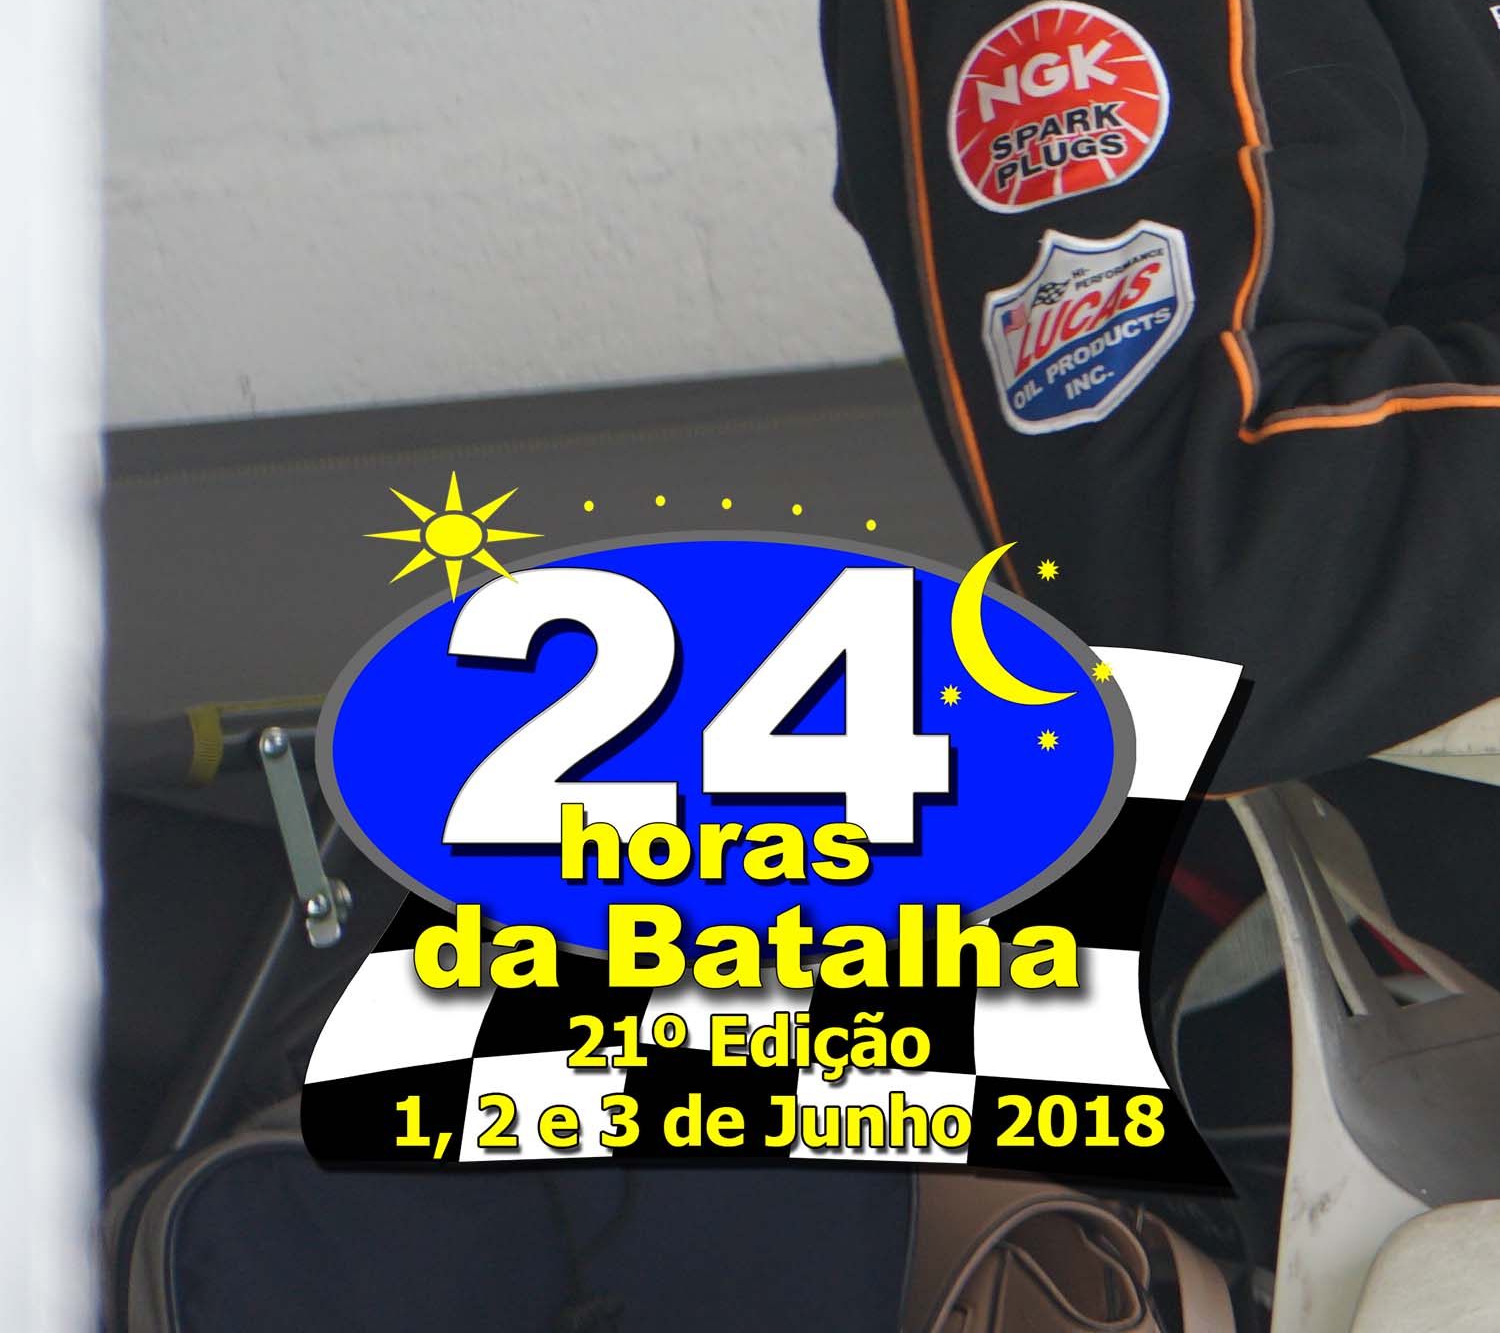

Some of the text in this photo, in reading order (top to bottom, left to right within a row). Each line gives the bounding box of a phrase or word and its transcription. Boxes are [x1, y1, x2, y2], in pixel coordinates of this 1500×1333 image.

[976, 39, 1118, 123] NGK
[991, 102, 1125, 162] SPARK
[996, 133, 1126, 191] PLUGS
[1075, 247, 1165, 290] PERFORMANCE
[1014, 262, 1162, 377] LUCAS
[1012, 307, 1172, 410] OIL PRODUCTS
